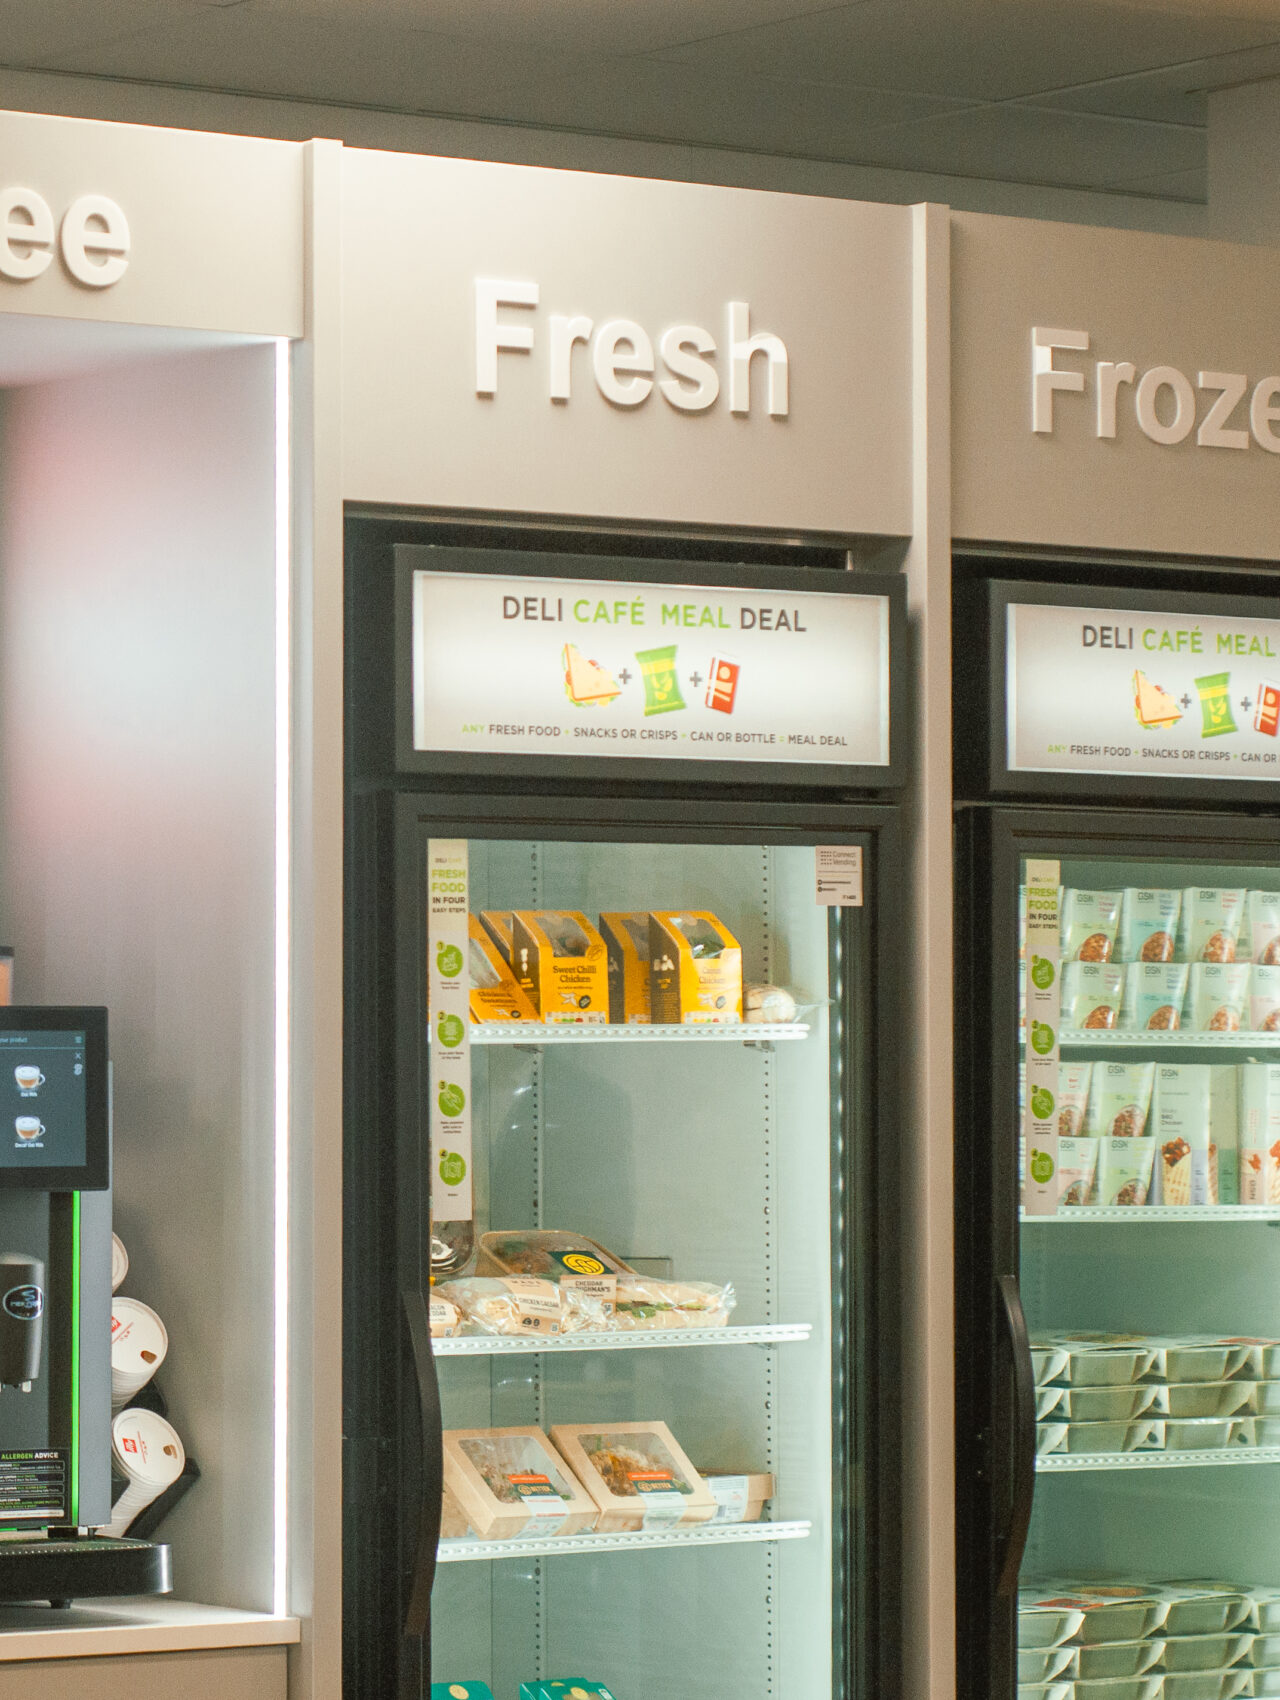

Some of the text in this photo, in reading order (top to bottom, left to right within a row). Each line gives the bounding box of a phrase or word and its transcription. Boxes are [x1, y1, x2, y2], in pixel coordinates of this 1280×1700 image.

[474, 278, 789, 416] Fresh
[503, 596, 807, 632] DELI CAFÉ MEAL DEAL
[1082, 625, 1276, 657] DELI CAFÉ MEAL
[462, 724, 847, 746] ANY FRESH FOOD SNACKS OR CRISPS CAN OR BOTTLE MEAL DEAL
[1048, 744, 1277, 763] ANY FRESH FOOD SNACKS OR CRISPS CAN OR
[432, 869, 466, 878] FRESH
[432, 883, 466, 892] FOOD
[1029, 888, 1057, 896] FRESH
[1029, 900, 1057, 910] FOOD
[577, 965, 597, 973] Chilli
